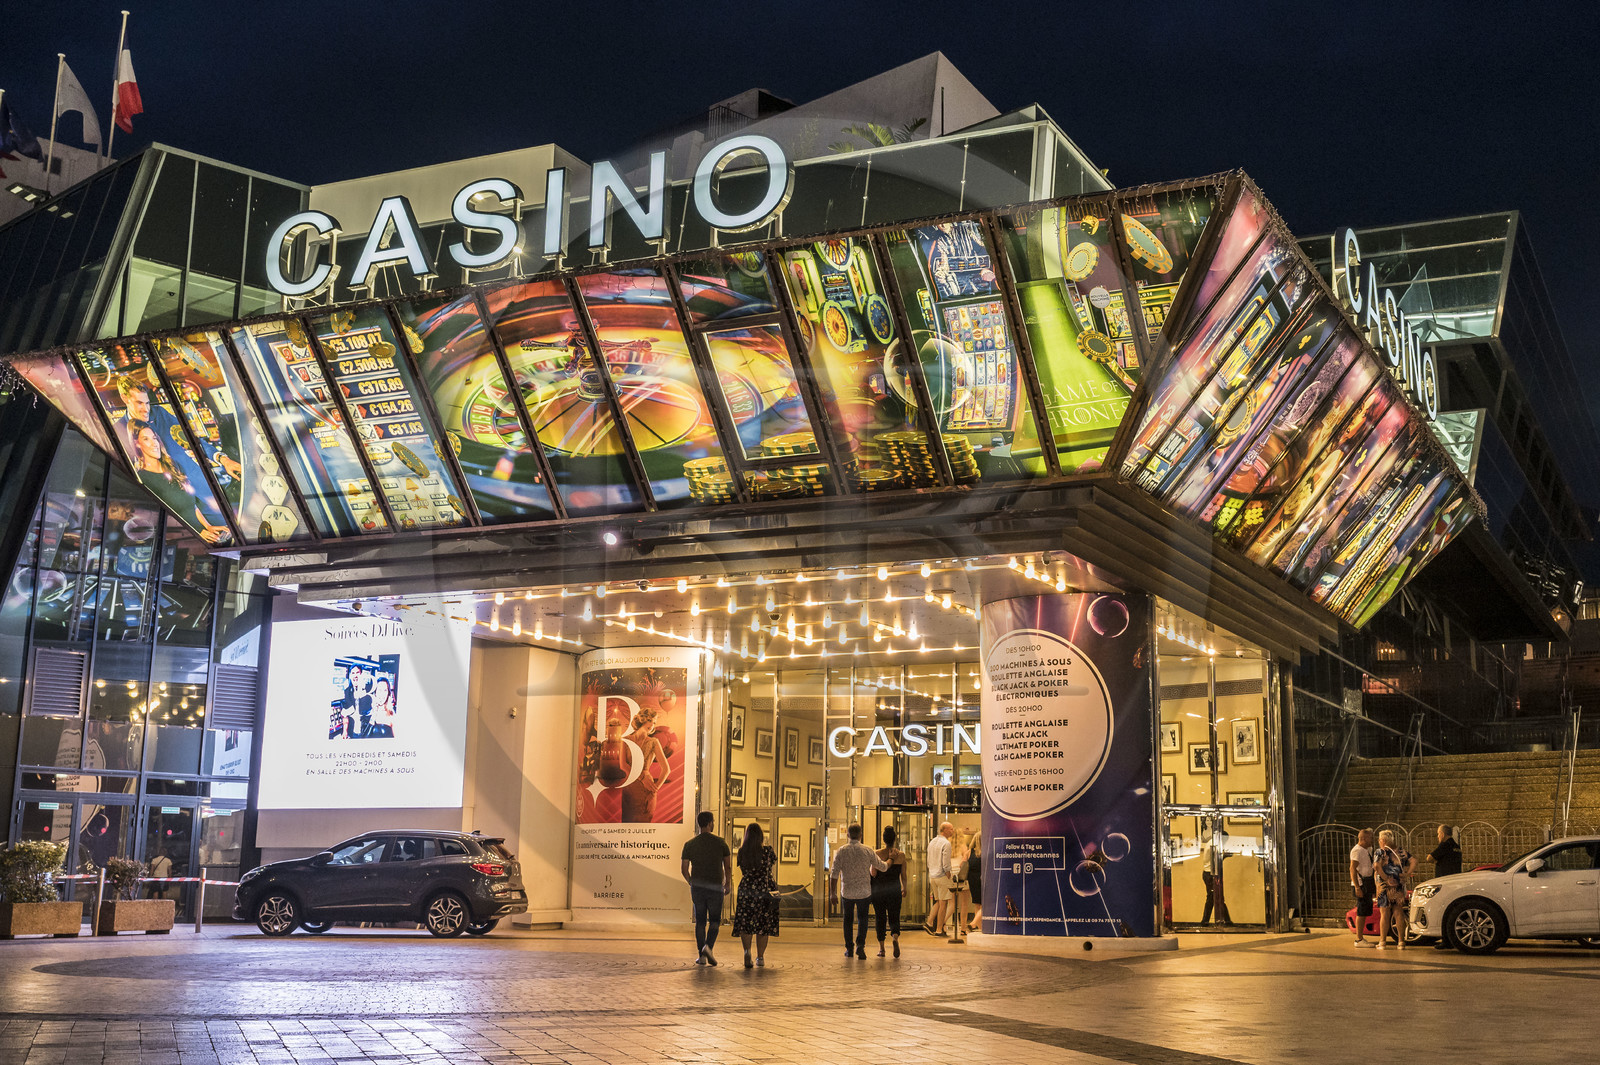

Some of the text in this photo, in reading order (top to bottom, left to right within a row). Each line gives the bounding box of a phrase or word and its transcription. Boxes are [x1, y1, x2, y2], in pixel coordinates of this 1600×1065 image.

[265, 134, 792, 297] CASINO
[1343, 227, 1438, 422] CASINO
[299, 367, 310, 381] 8
[314, 377, 404, 401] 7 €376,89
[1040, 380, 1118, 408] GAME OF
[369, 399, 414, 416] €154,26
[732, 400, 753, 413] 33
[388, 421, 424, 436] €31,03
[325, 625, 368, 640] Soirées
[371, 623, 388, 637] DJ
[600, 658, 614, 666] QUOI
[615, 656, 665, 664] AUJOURD'HUI
[1000, 660, 1038, 670] MACHINES
[1039, 658, 1046, 667] À
[1047, 658, 1072, 666] SOUS
[991, 668, 1068, 682] ROULETTE ANGLAISE
[991, 683, 1009, 692] BLACK
[1009, 681, 1028, 690] JACK
[1037, 679, 1069, 687] POKER
[996, 690, 1059, 701] ÉLECTRONIQUES
[1018, 704, 1043, 713] 20H00
[991, 719, 1069, 731] ROULETTE ANGLAISE
[828, 723, 982, 759] CASIN
[1002, 730, 1048, 740] BLACK JACK
[996, 740, 1060, 751] ULTIMATE POKER
[339, 751, 376, 759] VENDREDIS
[994, 751, 1064, 761] CASH GAME POKER
[1009, 784, 1032, 792] GAME
[1033, 783, 1064, 791] POKER
[620, 840, 670, 850] historique.
